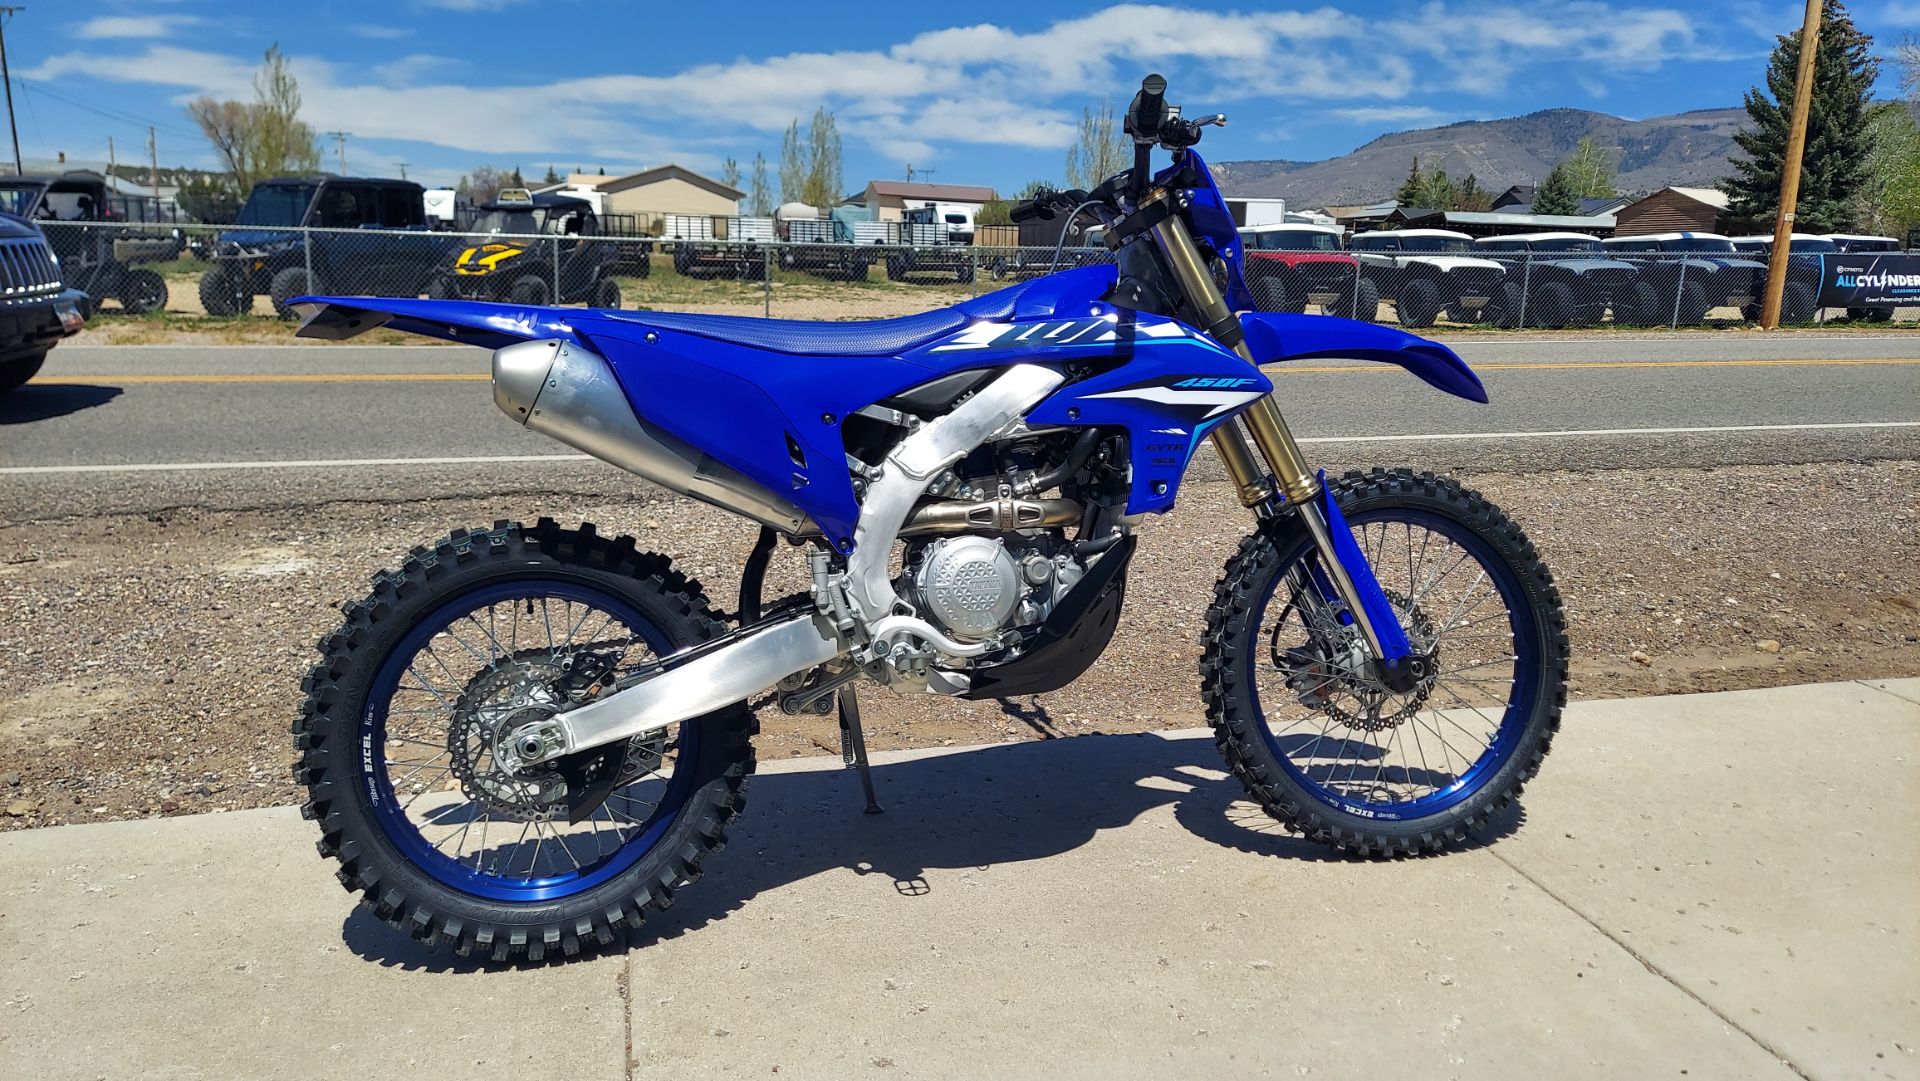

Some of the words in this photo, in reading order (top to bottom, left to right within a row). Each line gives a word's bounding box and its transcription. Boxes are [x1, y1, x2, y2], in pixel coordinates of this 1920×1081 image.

[1880, 296, 1903, 304] Financing
[1172, 378, 1258, 388] 450F
[363, 733, 373, 772] EXCEL
[1344, 804, 1374, 817] EXCEL
